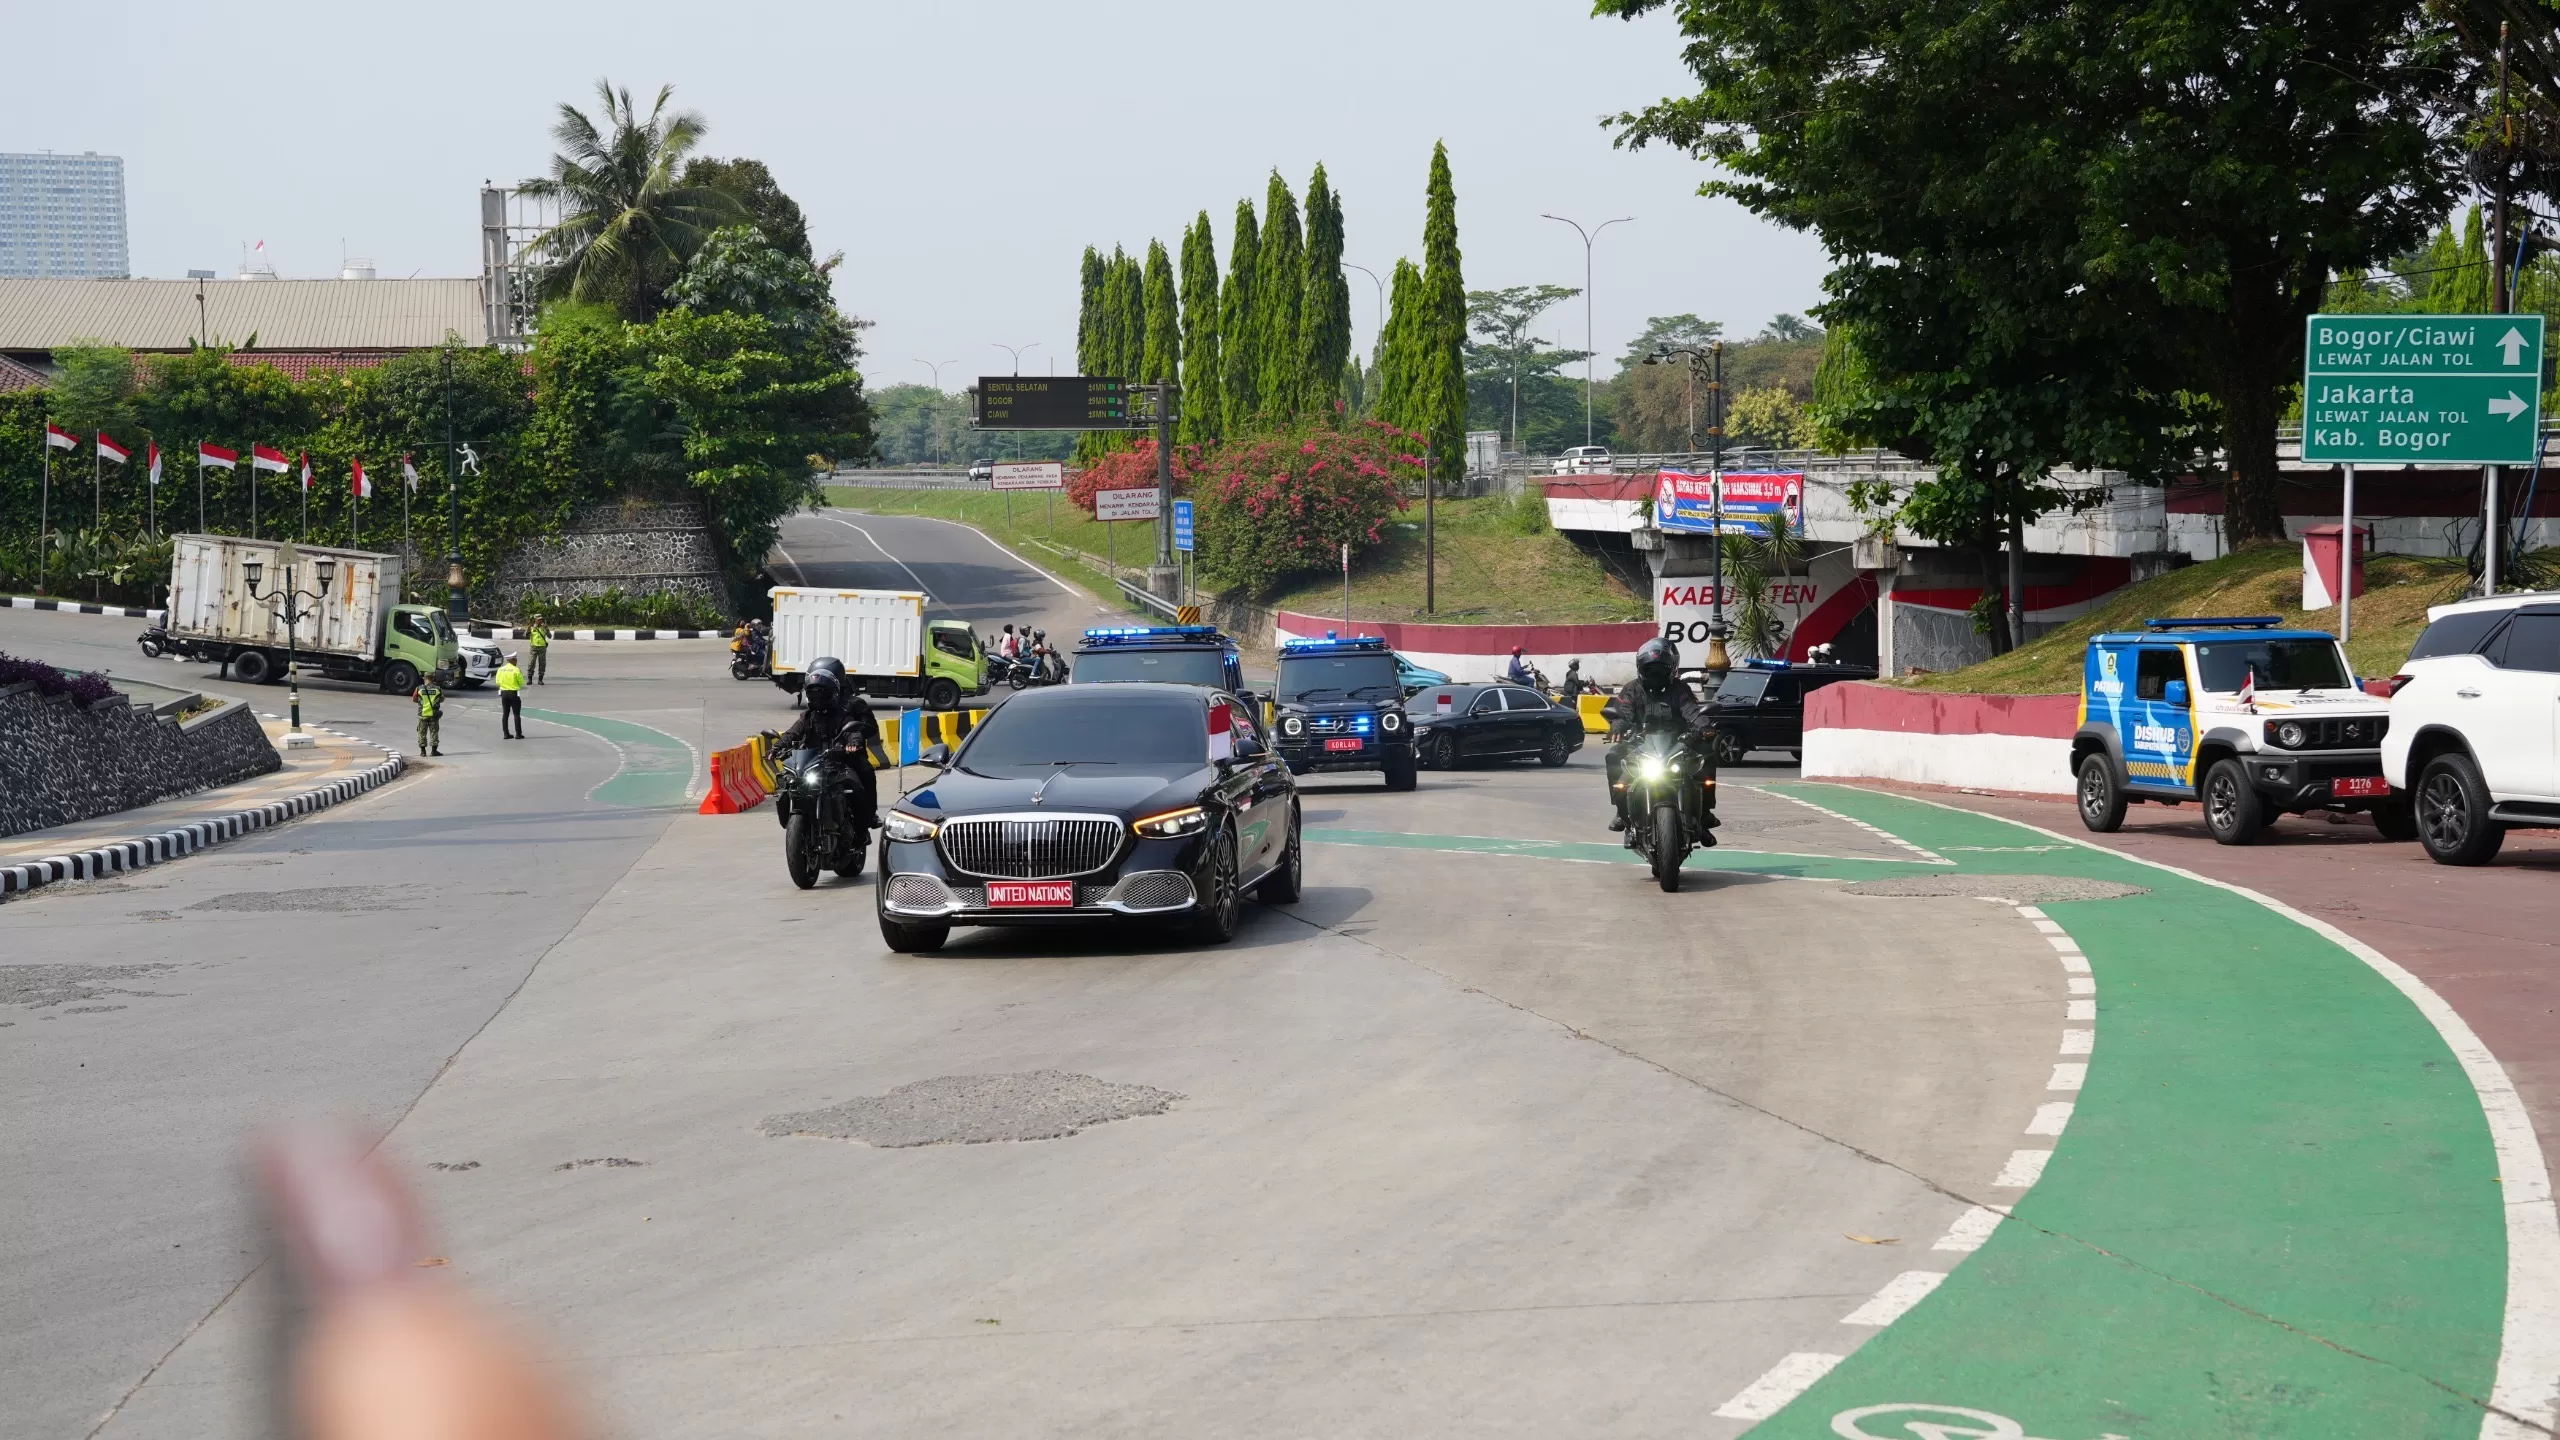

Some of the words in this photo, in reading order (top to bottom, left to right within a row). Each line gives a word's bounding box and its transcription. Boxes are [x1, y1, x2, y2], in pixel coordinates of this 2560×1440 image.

[2319, 327, 2475, 350] Bogor/Ciawi
[2318, 353, 2372, 366] LEWAT
[2380, 353, 2433, 366] JALAN
[2443, 353, 2473, 366] TOL
[987, 383, 1014, 392] SENTUL
[1016, 383, 1048, 392] SELATAN
[987, 397, 1013, 405] BOGOR
[2317, 385, 2414, 404] Jakarta
[987, 410, 1009, 419] CIAWI
[2315, 410, 2369, 423] LEWAT
[2377, 410, 2429, 423] JALAN
[2439, 410, 2469, 423] TOL
[2314, 429, 2365, 446] Kab.
[2379, 430, 2451, 452] Bogor
[1112, 492, 1153, 500] DILARANG
[1764, 482, 1774, 499] 3,5
[2094, 680, 2124, 694] PATROLI
[2134, 725, 2175, 743] DISHUB
[2334, 779, 2340, 790] F
[2349, 778, 2372, 789] 1176
[988, 886, 1026, 902] UNITED
[1028, 885, 1072, 902] NATIONS
